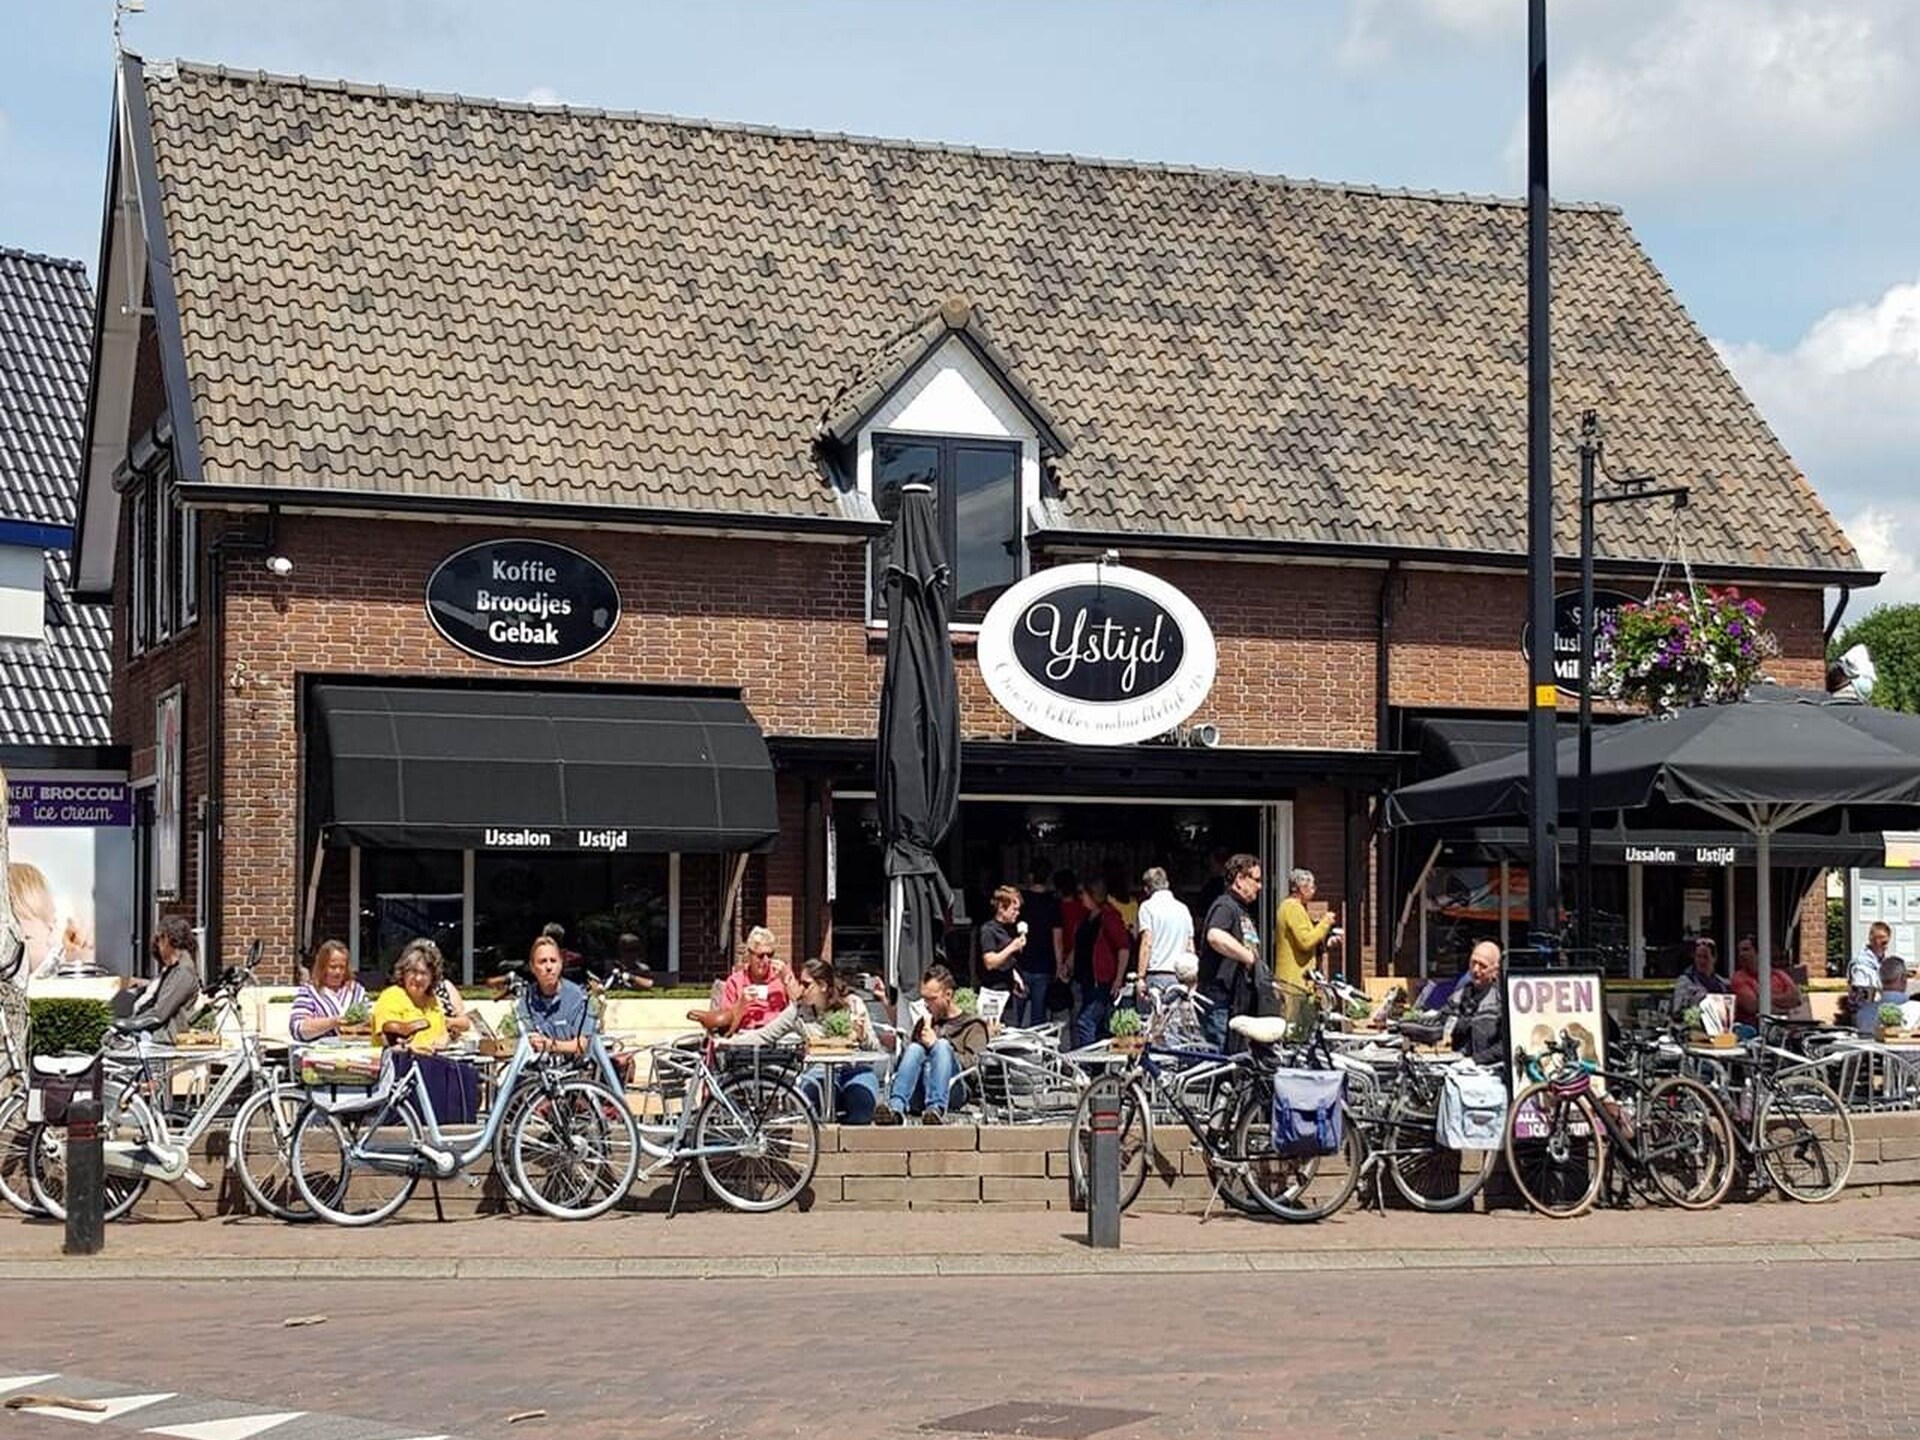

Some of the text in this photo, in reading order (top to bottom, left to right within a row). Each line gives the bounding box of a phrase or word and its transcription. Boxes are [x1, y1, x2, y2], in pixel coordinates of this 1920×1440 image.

[492, 560, 557, 583] Koffie
[476, 590, 571, 619] Broodjes
[489, 621, 560, 645] Gebak
[1025, 602, 1165, 692] Ystijd
[40, 787, 124, 801] BROCCOLI
[33, 800, 58, 820] ice
[61, 806, 113, 820] cream
[1512, 981, 1594, 1014] OPEN
